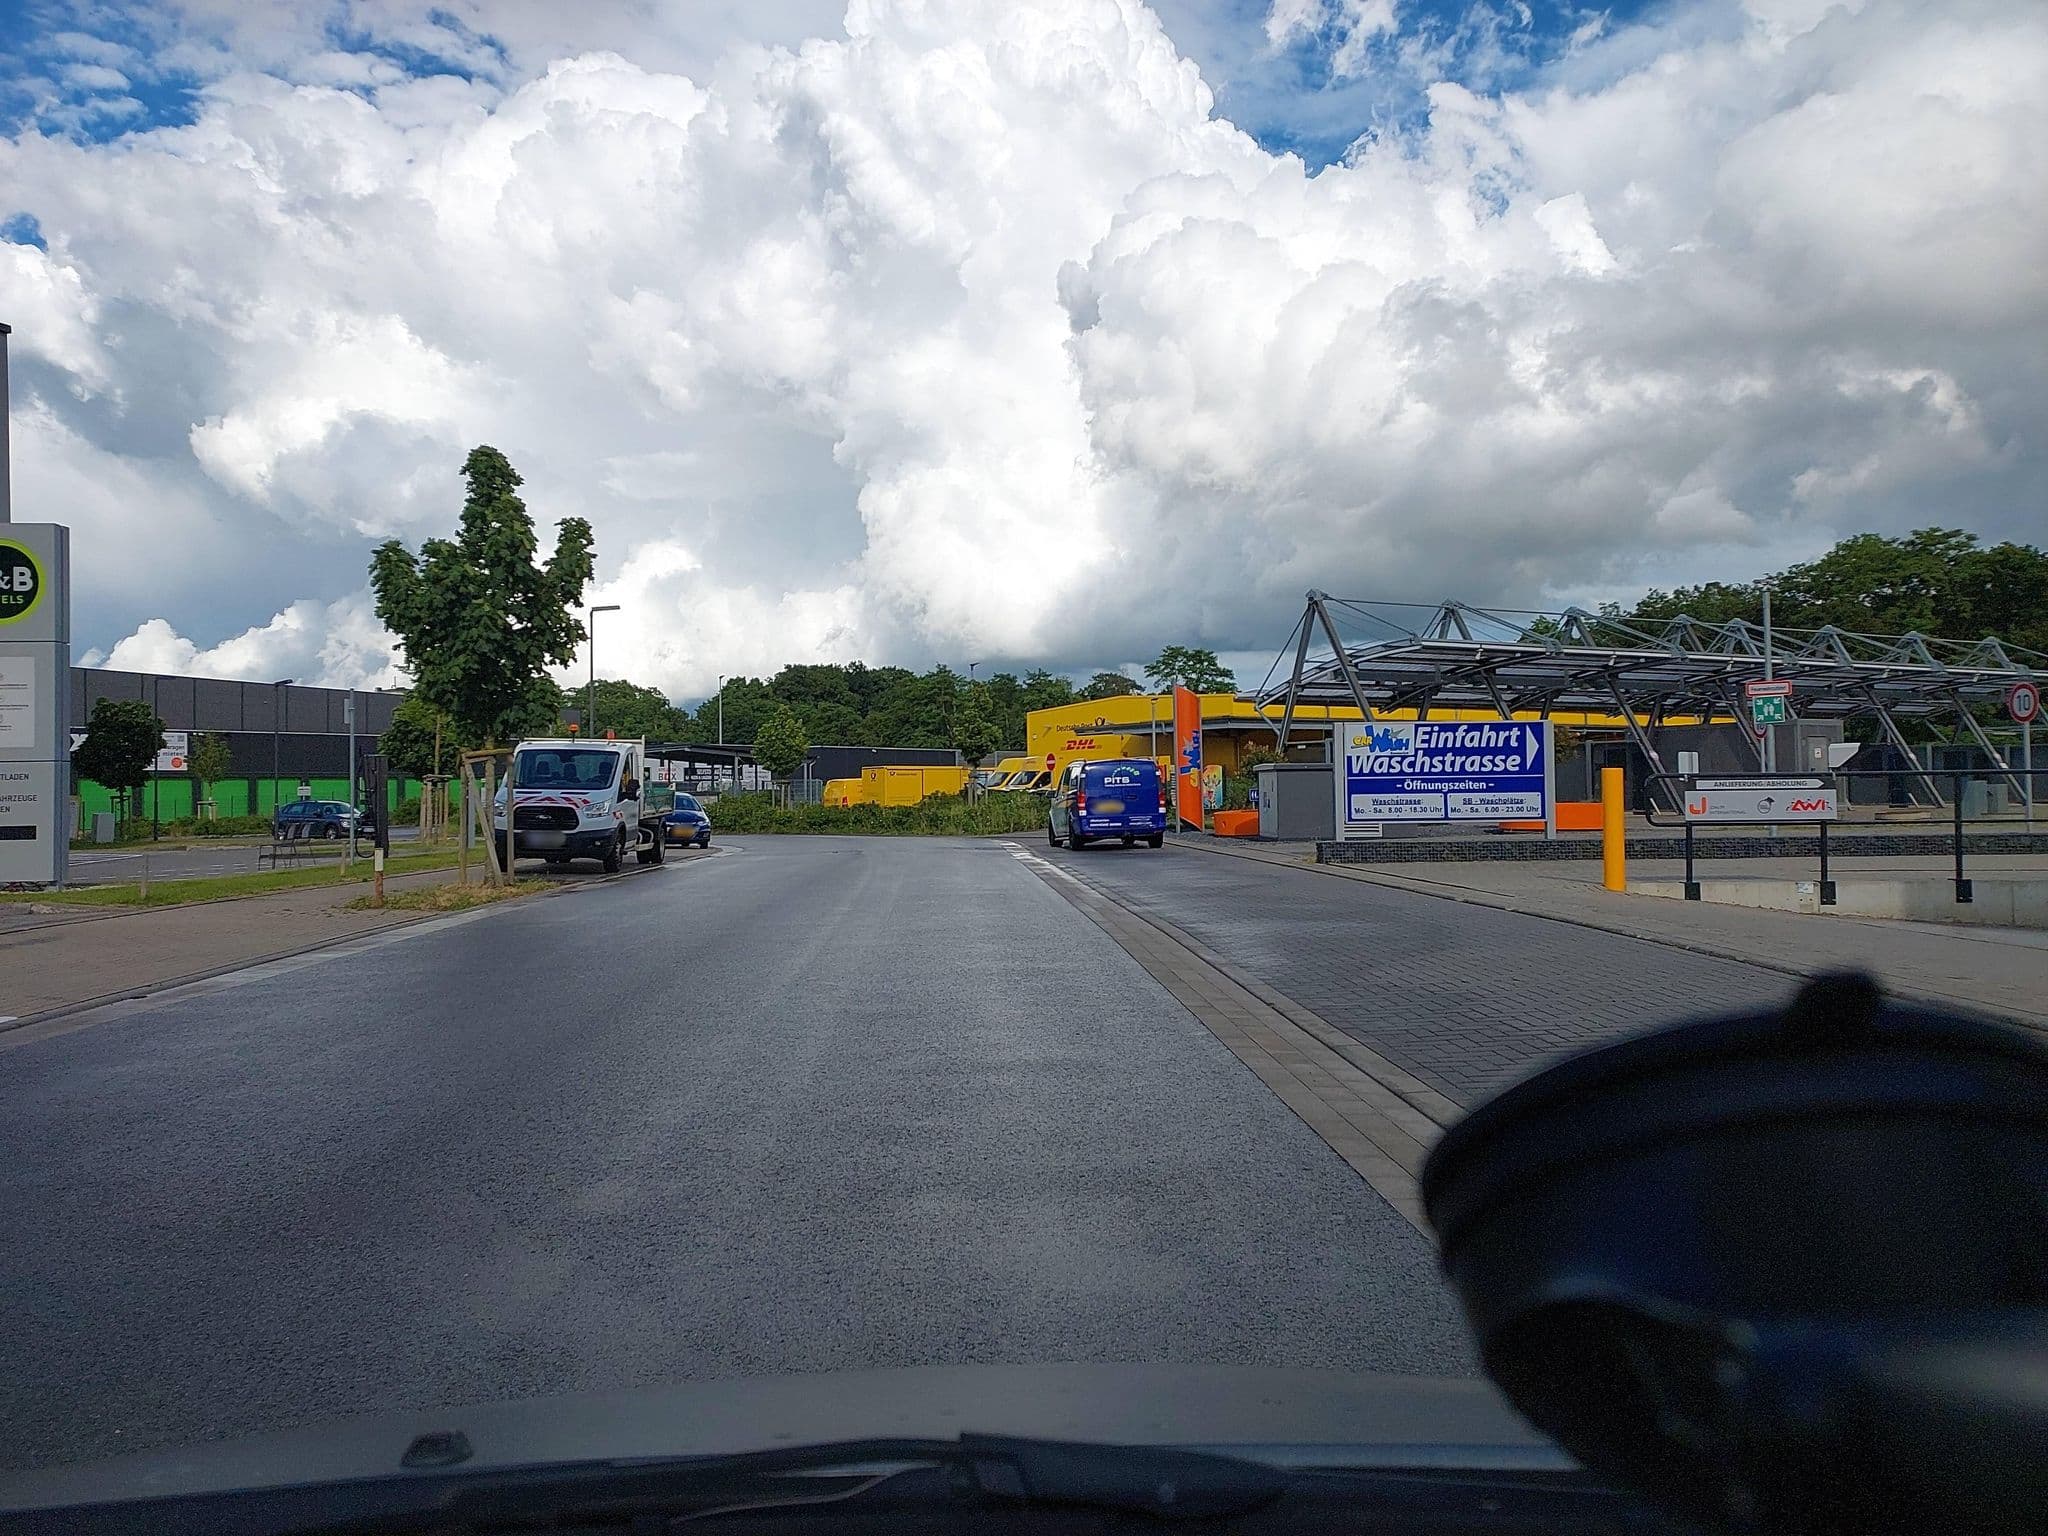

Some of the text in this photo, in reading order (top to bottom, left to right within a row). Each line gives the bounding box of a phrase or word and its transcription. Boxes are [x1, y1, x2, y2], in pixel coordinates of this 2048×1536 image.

[0, 566, 33, 591] &B
[2016, 694, 2030, 712] 10
[1415, 725, 1520, 748] Einfahrt
[1066, 739, 1096, 750] DHL
[1352, 750, 1520, 773] Waschstrasse
[1404, 779, 1486, 792] Öffnungszeiten
[1429, 805, 1443, 813] Uhr
[1526, 804, 1539, 813] Uhr
